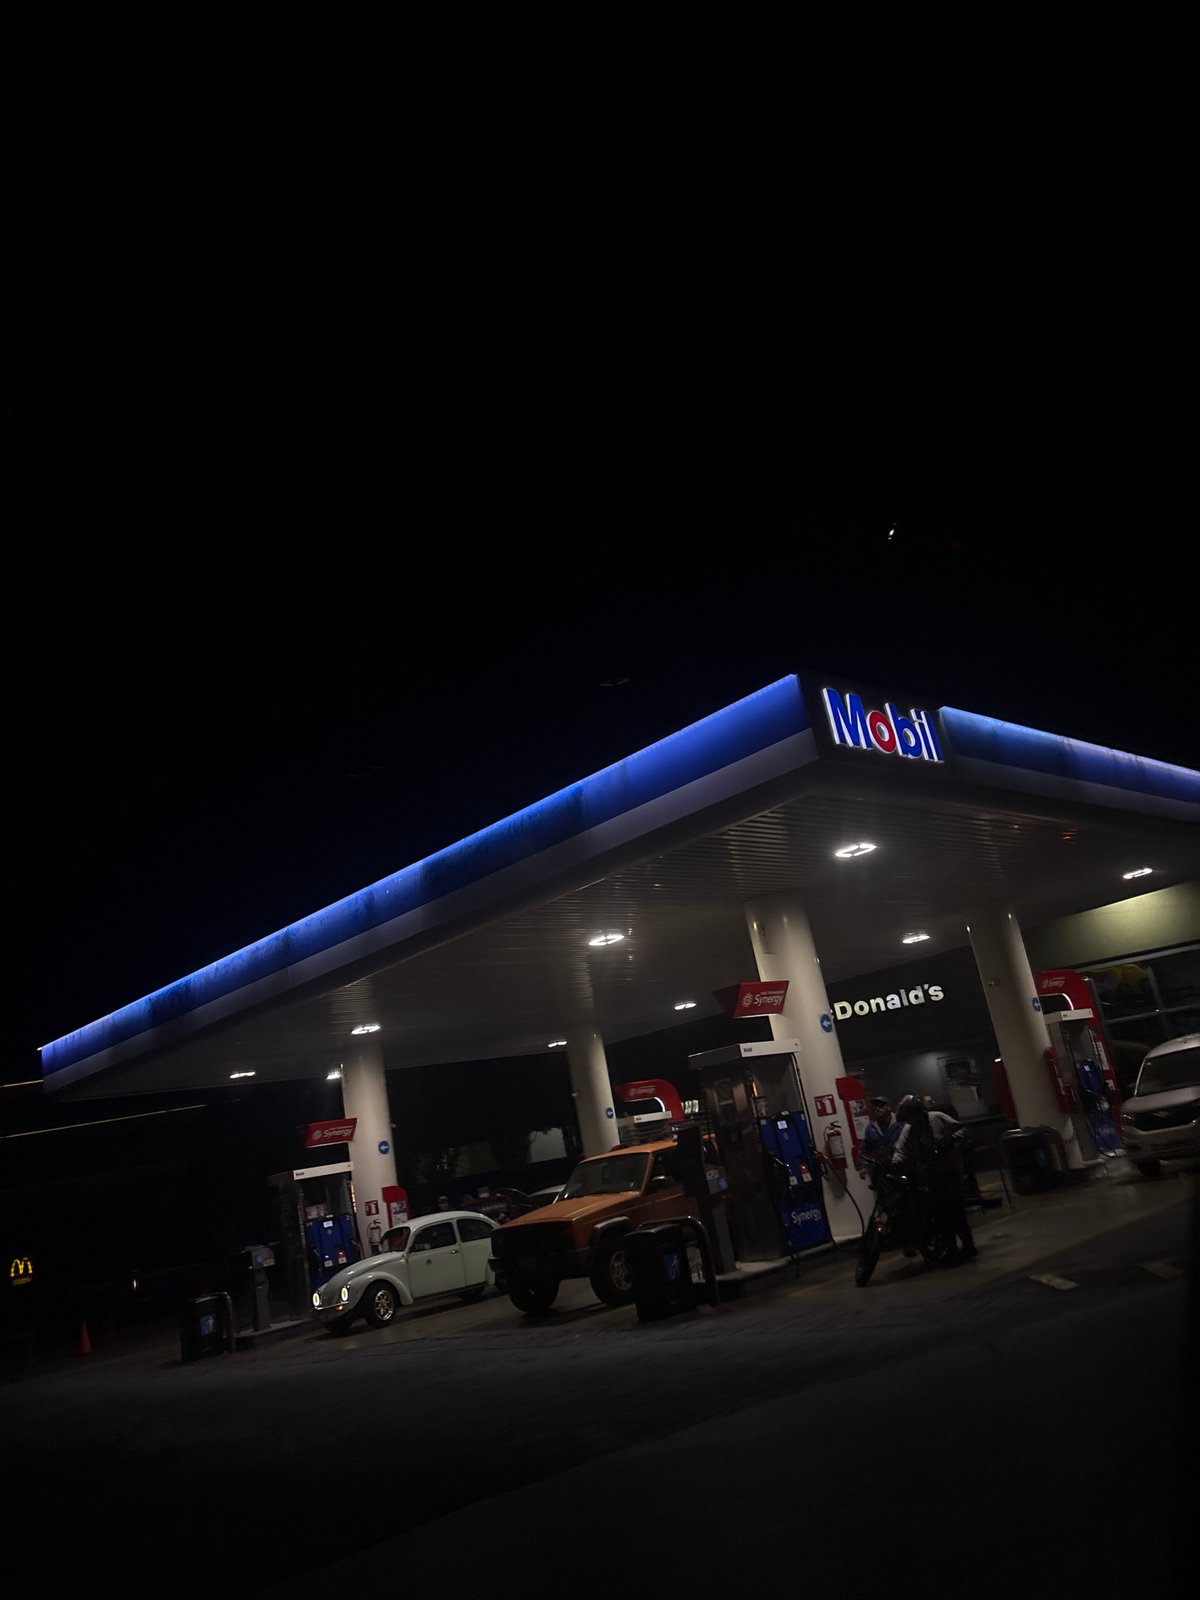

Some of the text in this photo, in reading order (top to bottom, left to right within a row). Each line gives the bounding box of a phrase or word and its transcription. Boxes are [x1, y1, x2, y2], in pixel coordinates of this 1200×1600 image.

[822, 687, 945, 763] Mobil
[753, 993, 785, 1007] Synergy
[829, 984, 945, 1021] Donald's
[322, 1128, 353, 1139] Synergy
[790, 1208, 822, 1226] Synergy
